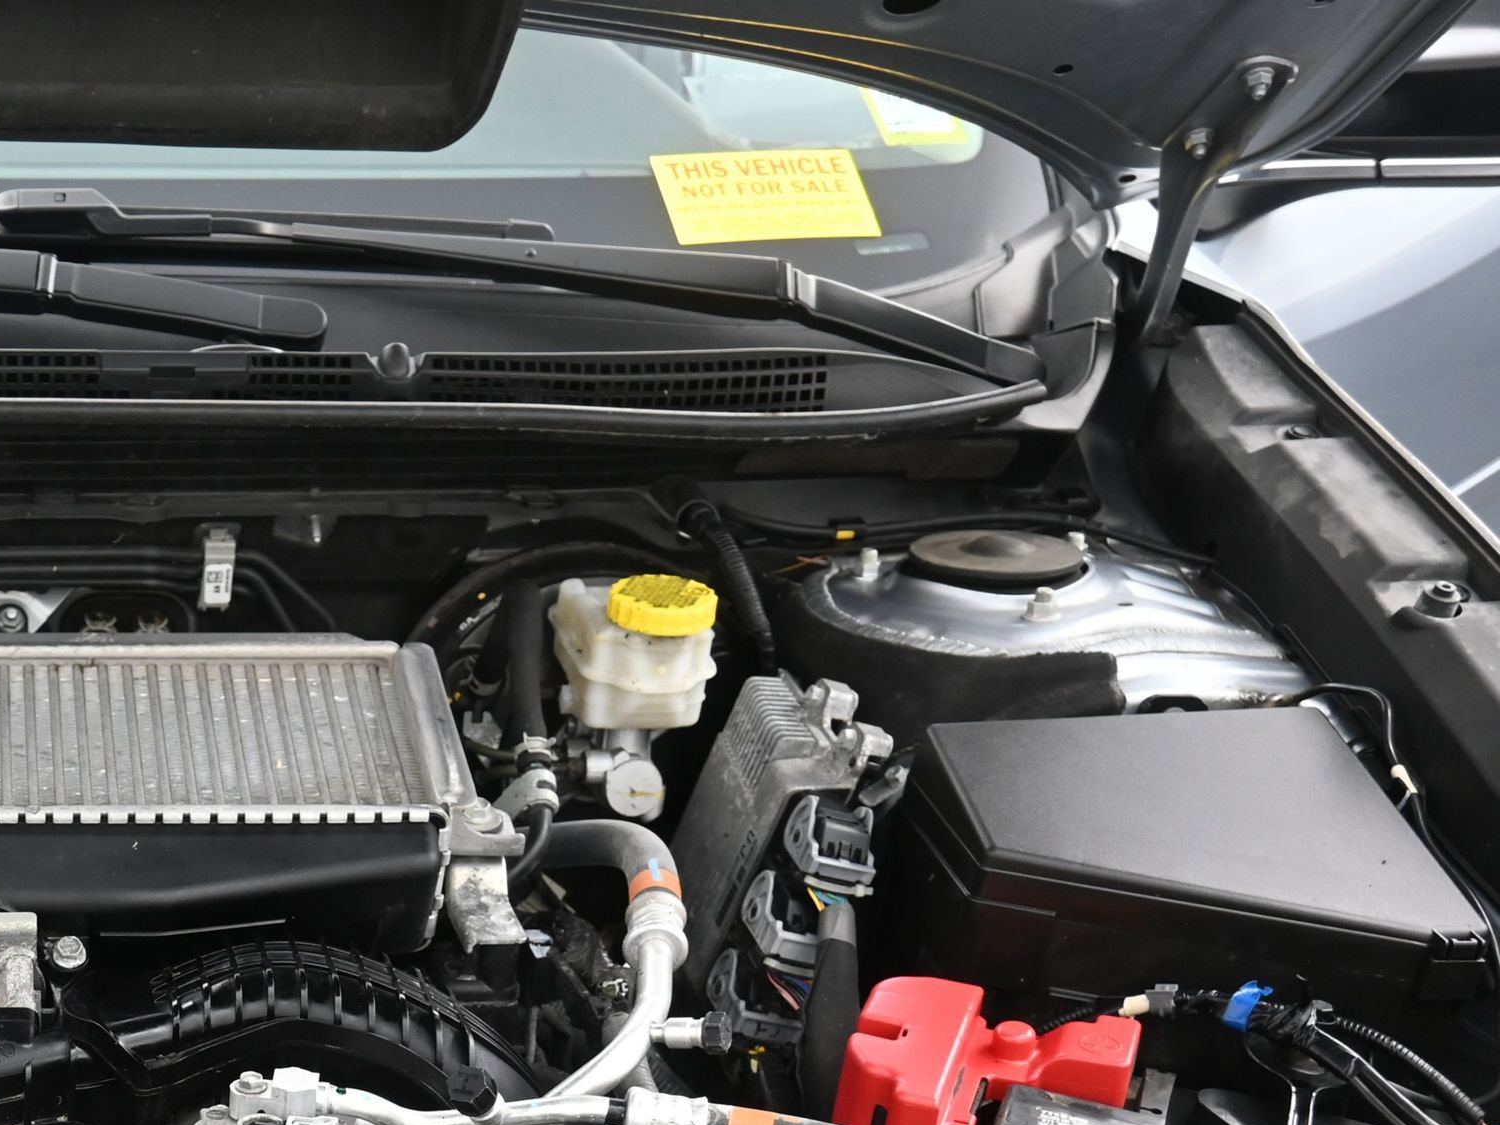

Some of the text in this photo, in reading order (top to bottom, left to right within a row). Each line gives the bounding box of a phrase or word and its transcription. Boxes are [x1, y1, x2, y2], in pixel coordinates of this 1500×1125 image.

[666, 156, 848, 180] THIS VEHICLE
[681, 179, 850, 198] NOT FOR SALE
